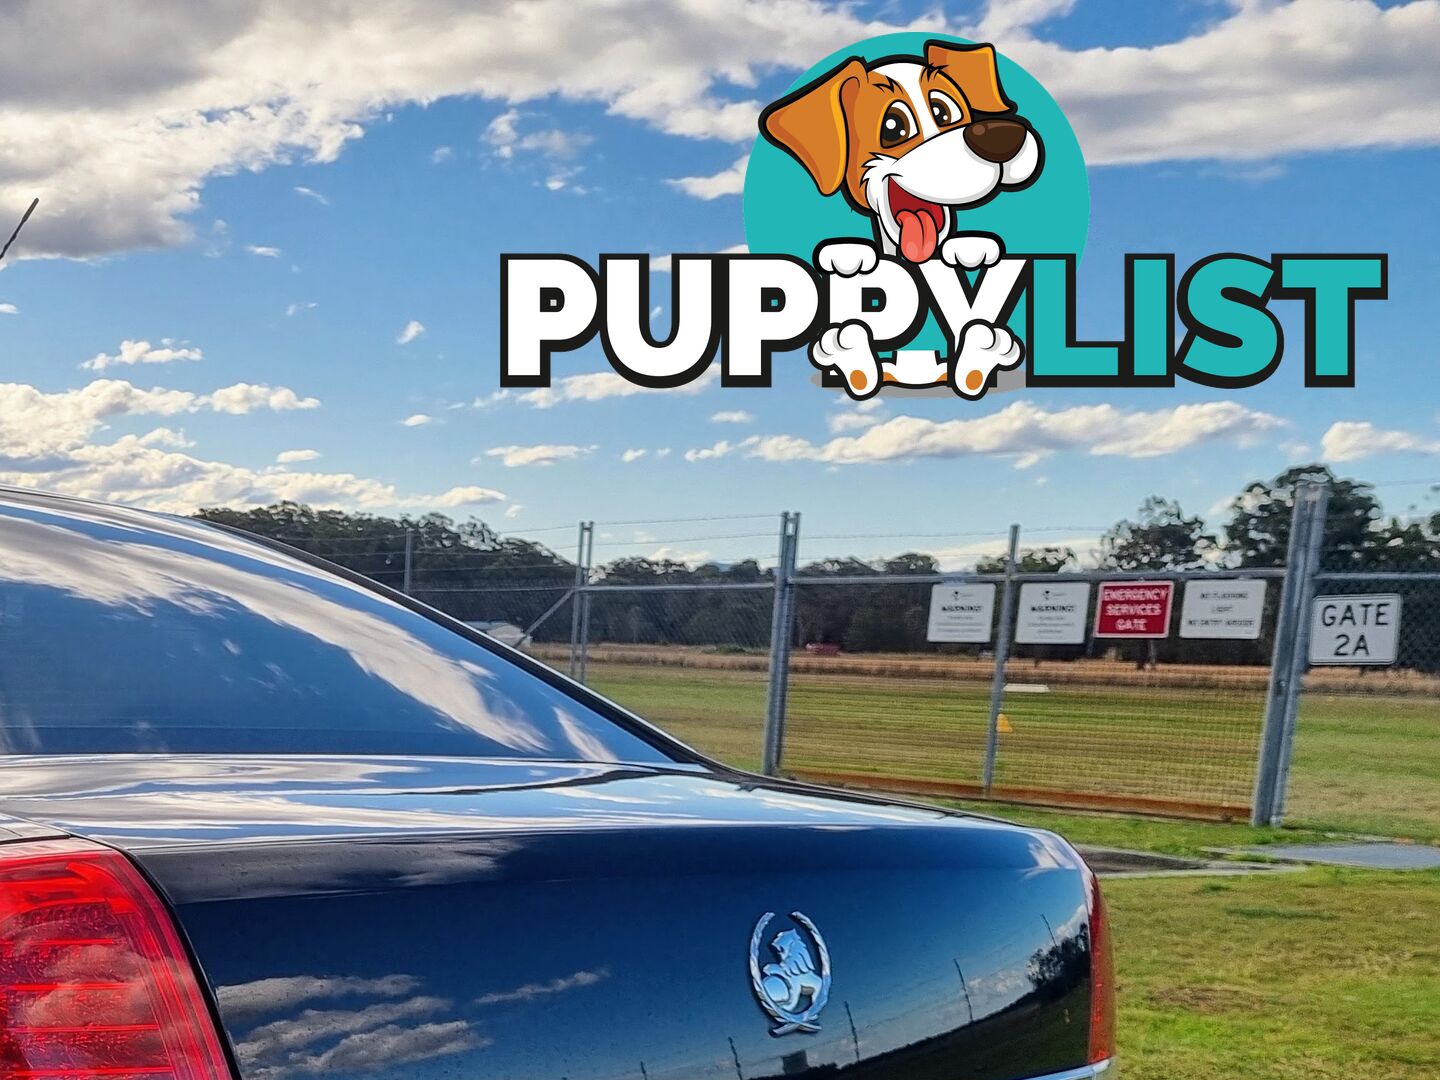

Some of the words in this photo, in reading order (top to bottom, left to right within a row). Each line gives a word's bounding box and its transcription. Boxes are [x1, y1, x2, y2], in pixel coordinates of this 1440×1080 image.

[1104, 588, 1168, 601] EMERGENCY
[1105, 603, 1161, 616] SERVICES
[1322, 603, 1390, 626] GATE
[1115, 618, 1148, 630] GATE
[1333, 634, 1369, 656] 2A
